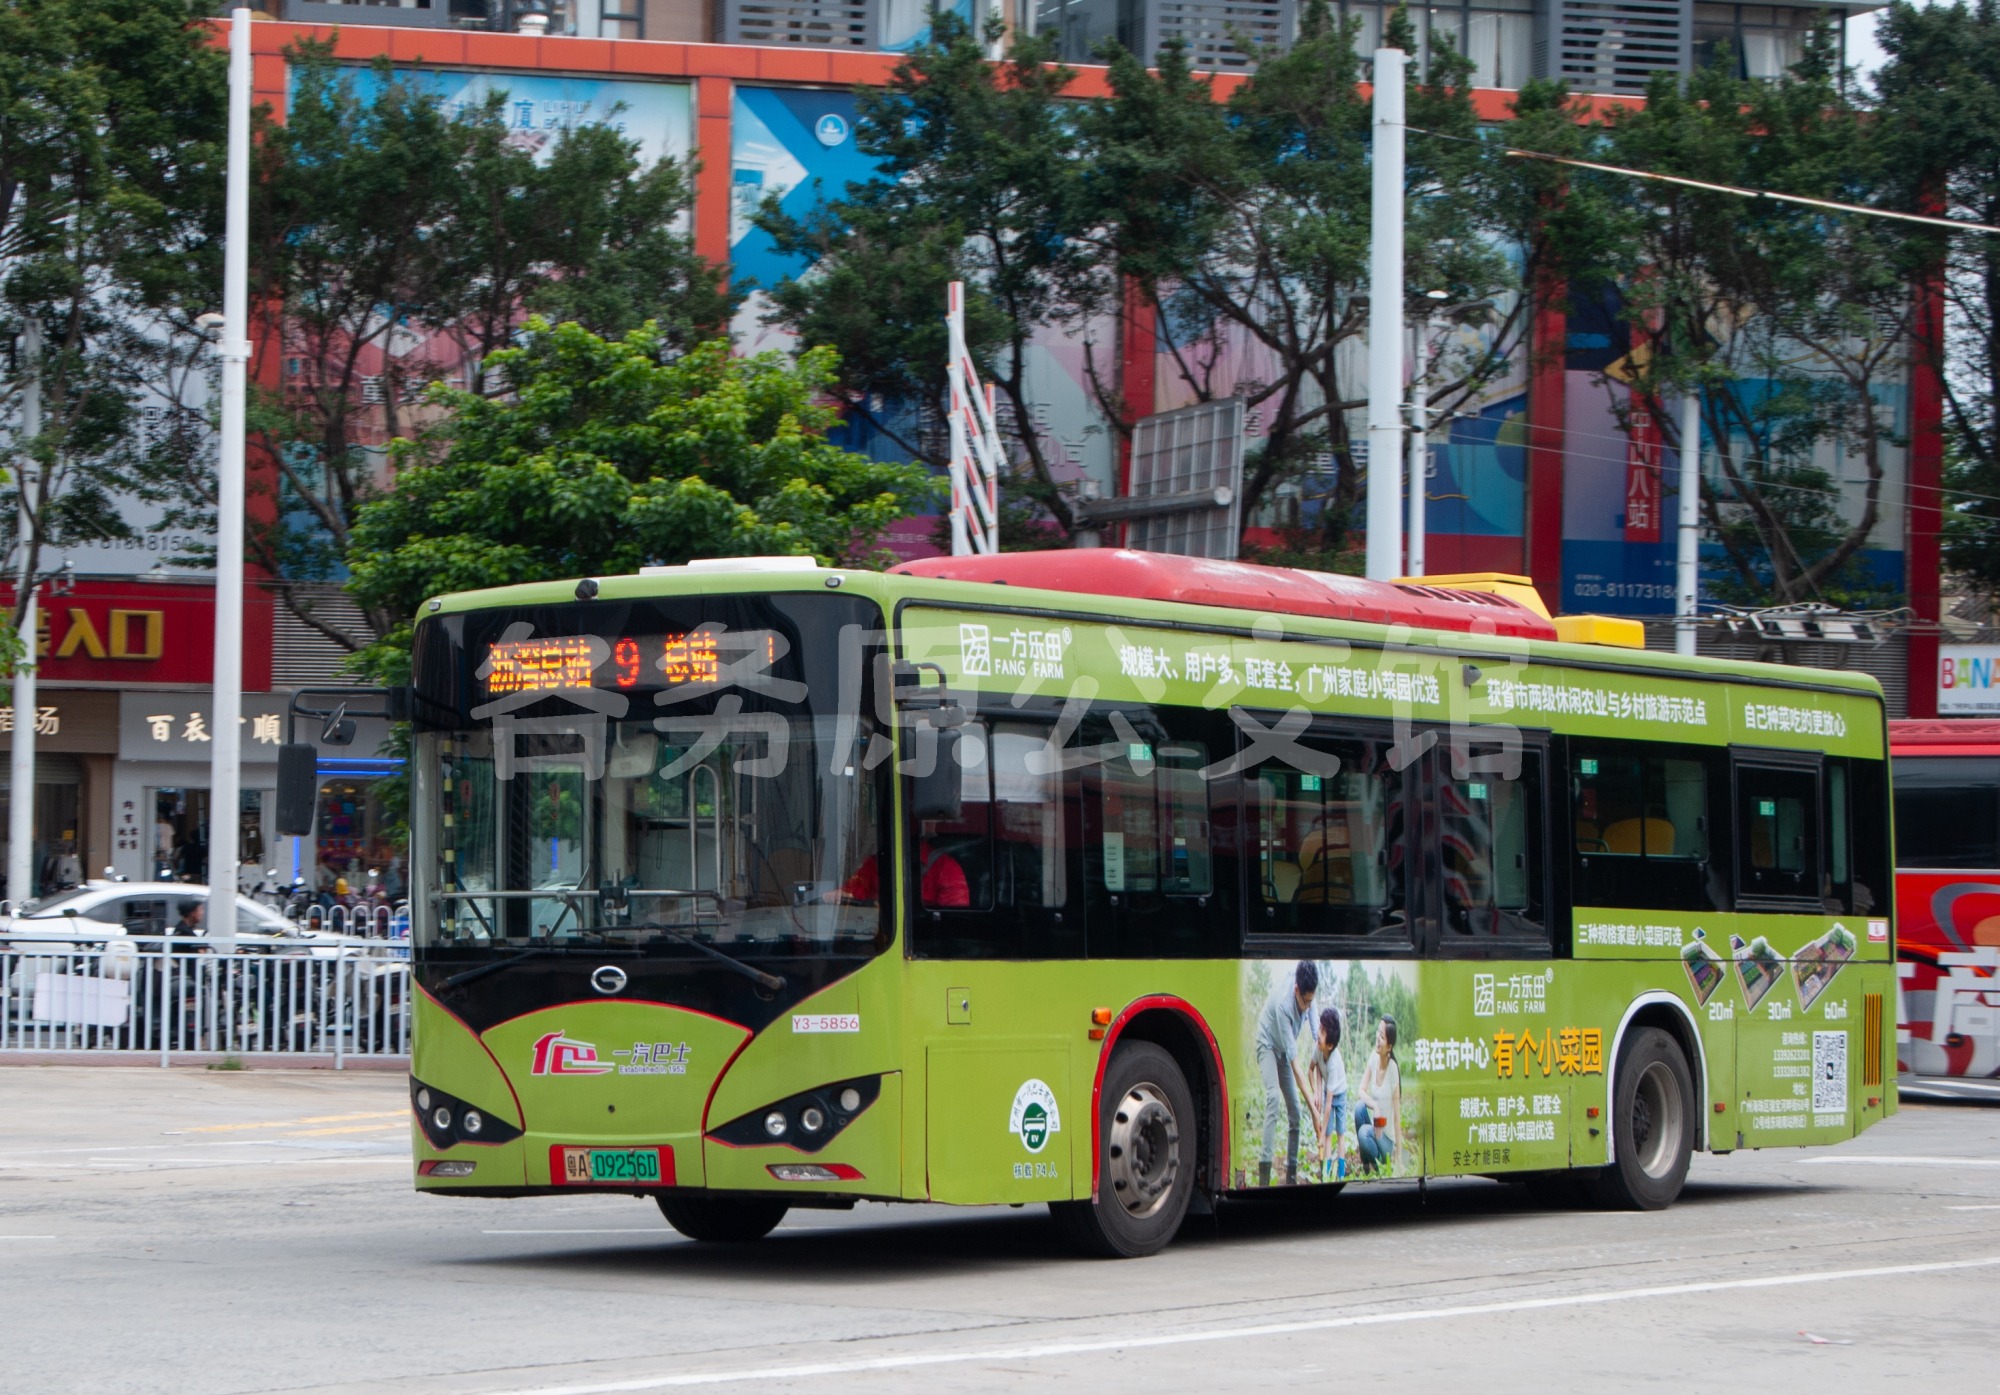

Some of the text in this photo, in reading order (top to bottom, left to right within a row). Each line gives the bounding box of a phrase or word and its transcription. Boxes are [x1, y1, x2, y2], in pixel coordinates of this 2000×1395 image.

[614, 637, 640, 687] 9
[994, 659, 1064, 680] FANG FARM
[146, 713, 282, 745] 百衣順
[1744, 701, 1846, 737] 自己种菜吃的更放心
[1578, 924, 1683, 947] 三种规格家庭小菜园可选
[1496, 1000, 1546, 1014] FANG FARM
[793, 1016, 859, 1031] Y3-5856
[613, 1041, 691, 1065] 一汽巴士
[1414, 1026, 1604, 1079] 我在市中心 有个小菜园
[619, 1065, 659, 1074] Established
[669, 1065, 685, 1074] 1952
[1468, 1120, 1555, 1145] 广州家庭小菜园优选
[1452, 1148, 1511, 1168] 安全才能回家
